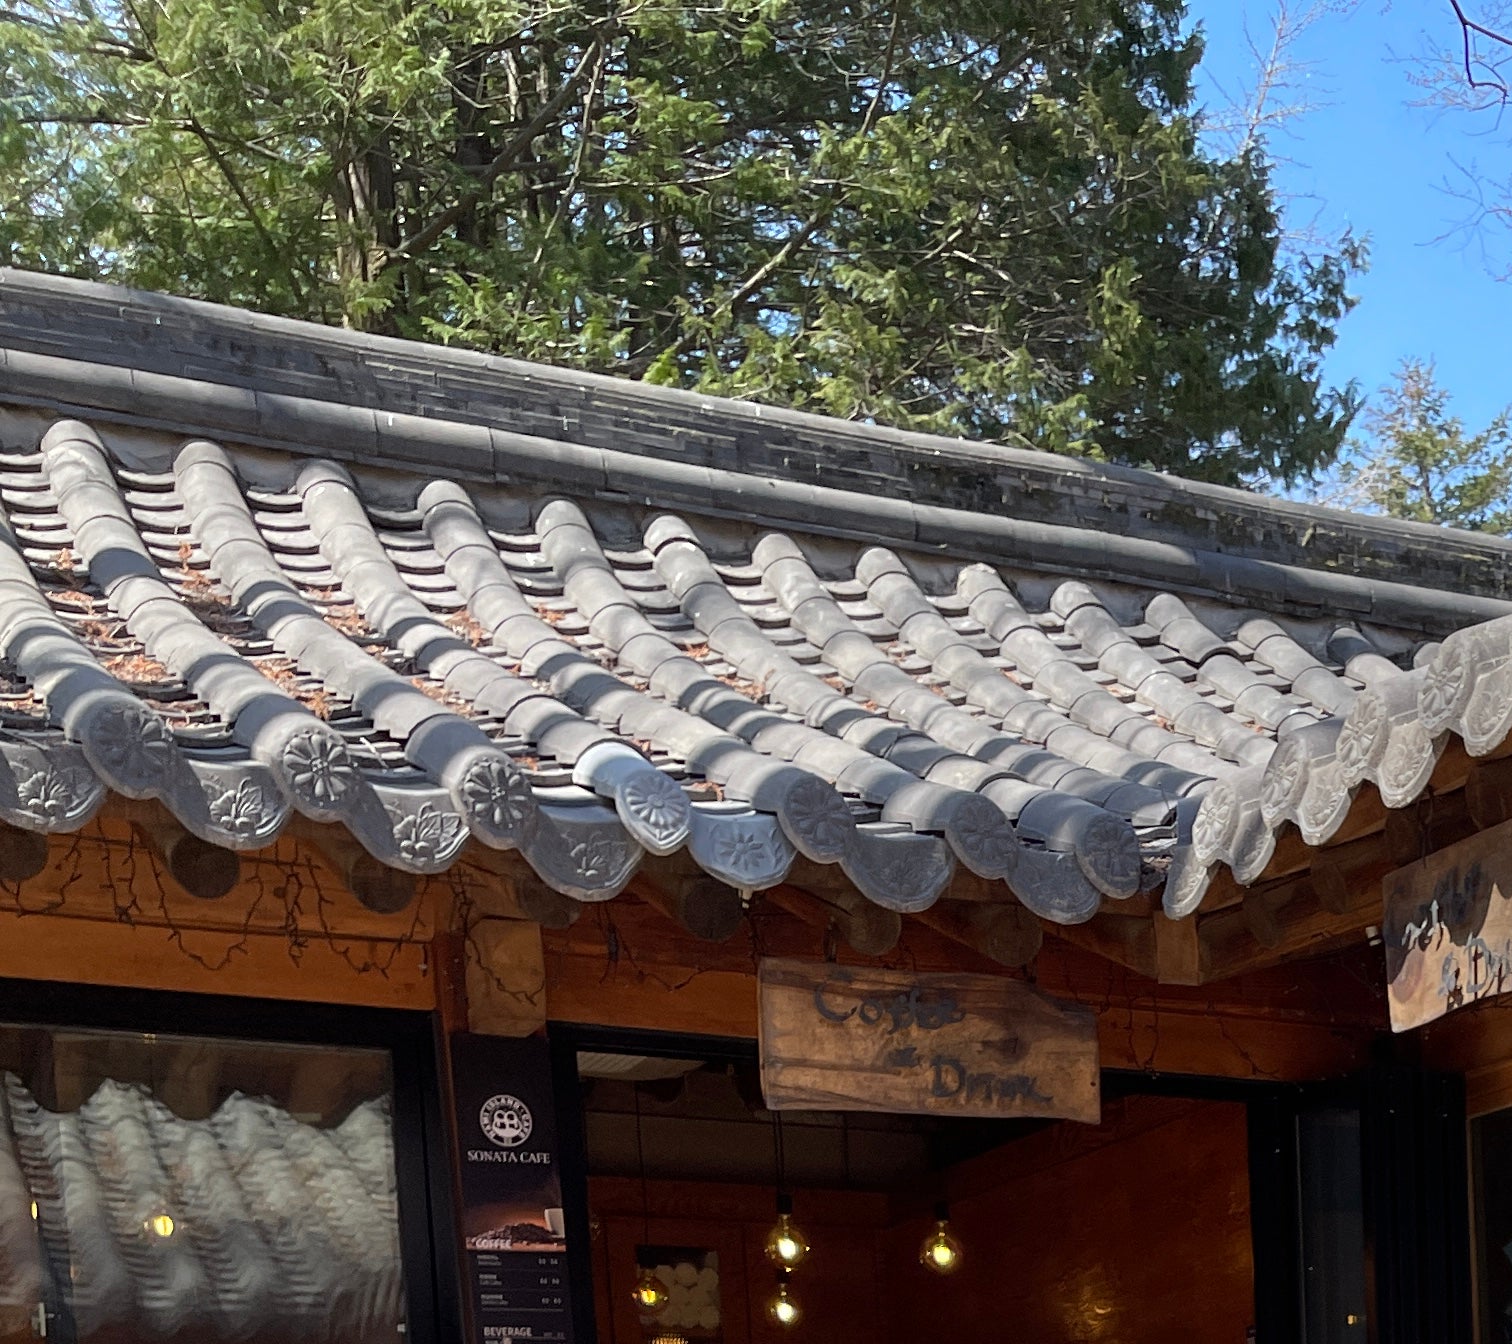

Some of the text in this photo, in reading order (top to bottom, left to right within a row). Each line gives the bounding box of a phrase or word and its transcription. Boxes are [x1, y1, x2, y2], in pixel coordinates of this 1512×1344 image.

[813, 980, 967, 1035] Coffee
[929, 1054, 1055, 1105] Drink
[467, 1150, 551, 1164] SONATA CAFE
[475, 1238, 512, 1250] COFFEE
[483, 1326, 532, 1337] BEVERAGE
